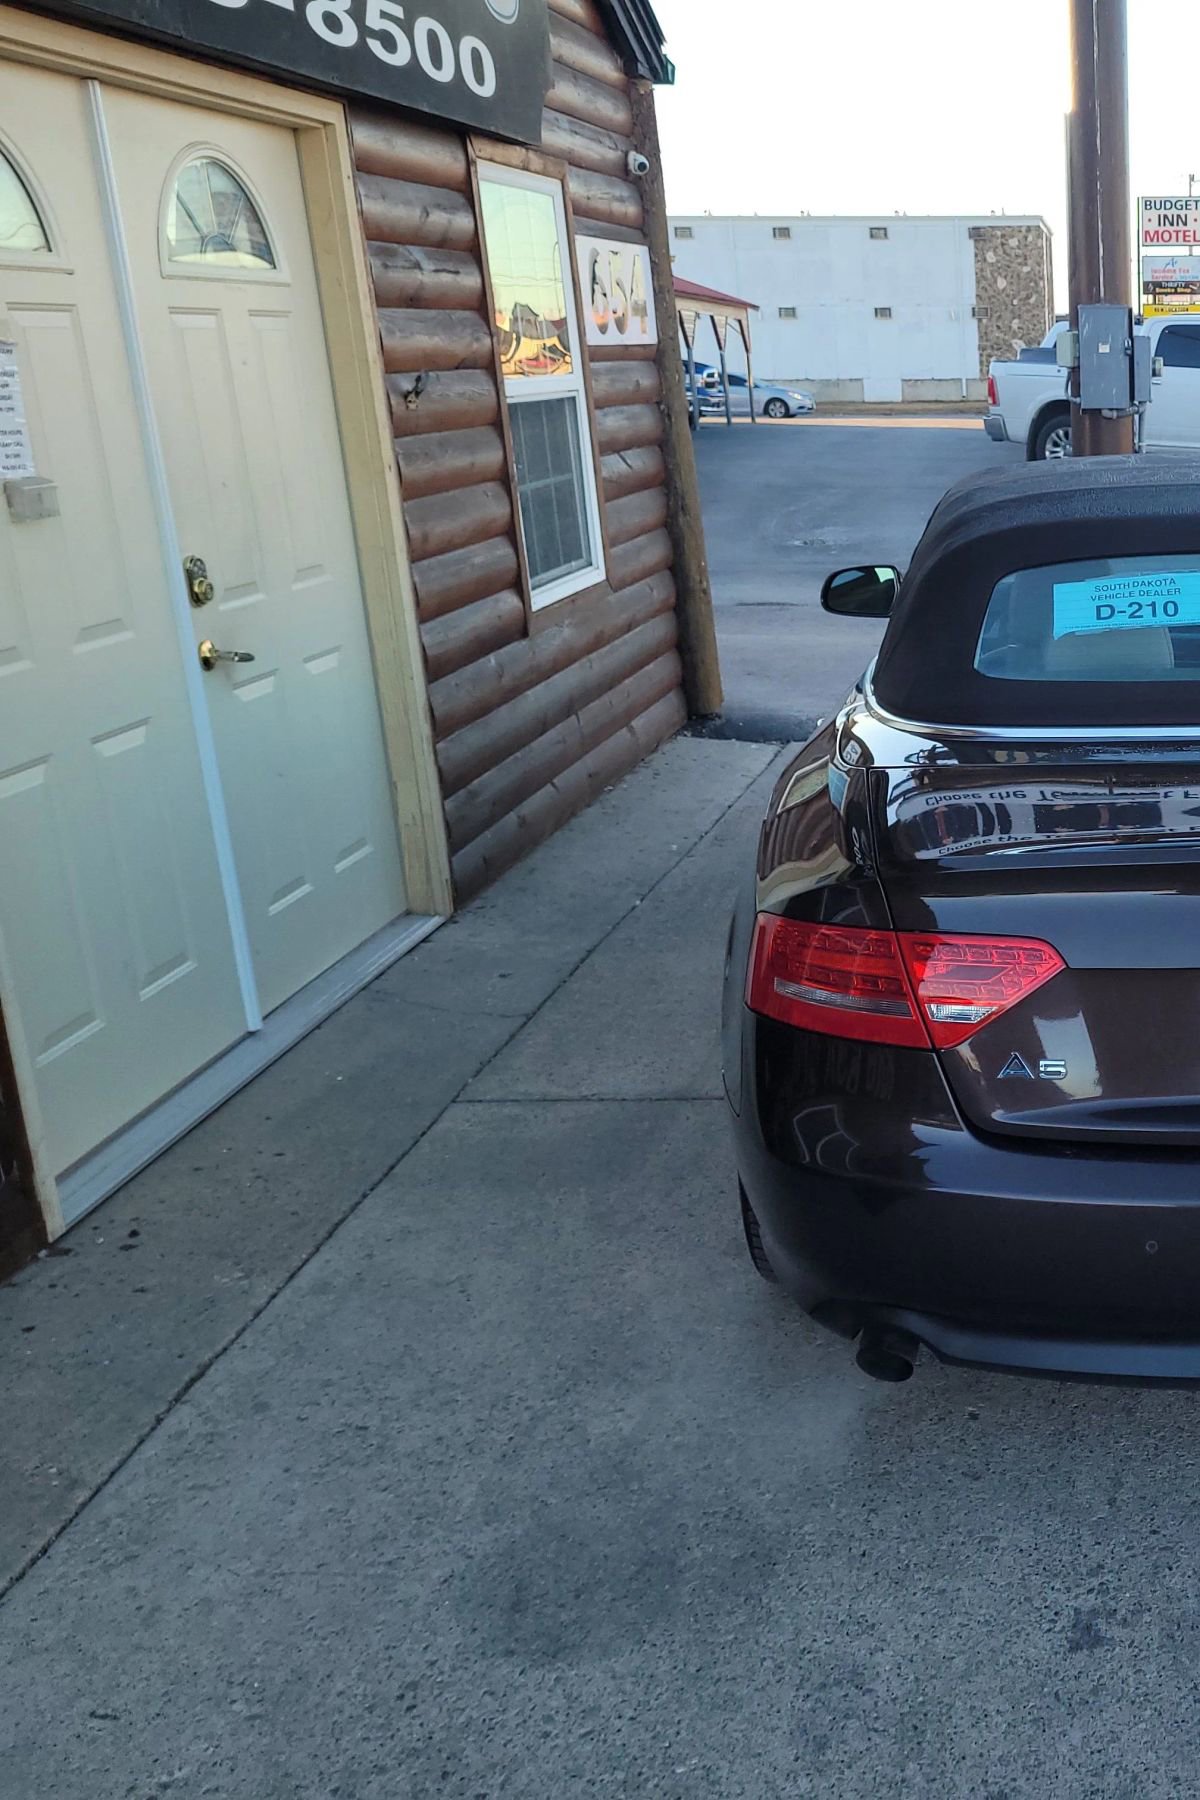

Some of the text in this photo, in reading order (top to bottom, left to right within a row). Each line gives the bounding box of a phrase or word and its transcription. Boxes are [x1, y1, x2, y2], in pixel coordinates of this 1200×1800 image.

[1144, 199, 1200, 211] BUDGET
[1158, 213, 1188, 227] INN
[1144, 229, 1200, 243] MOTEL
[589, 248, 648, 335] 654
[1094, 578, 1176, 593] SOUTH DAKOTA
[1090, 587, 1181, 602] VEHICLE DEALER
[1095, 600, 1179, 621] D-210
[997, 1051, 1068, 1081] A5
